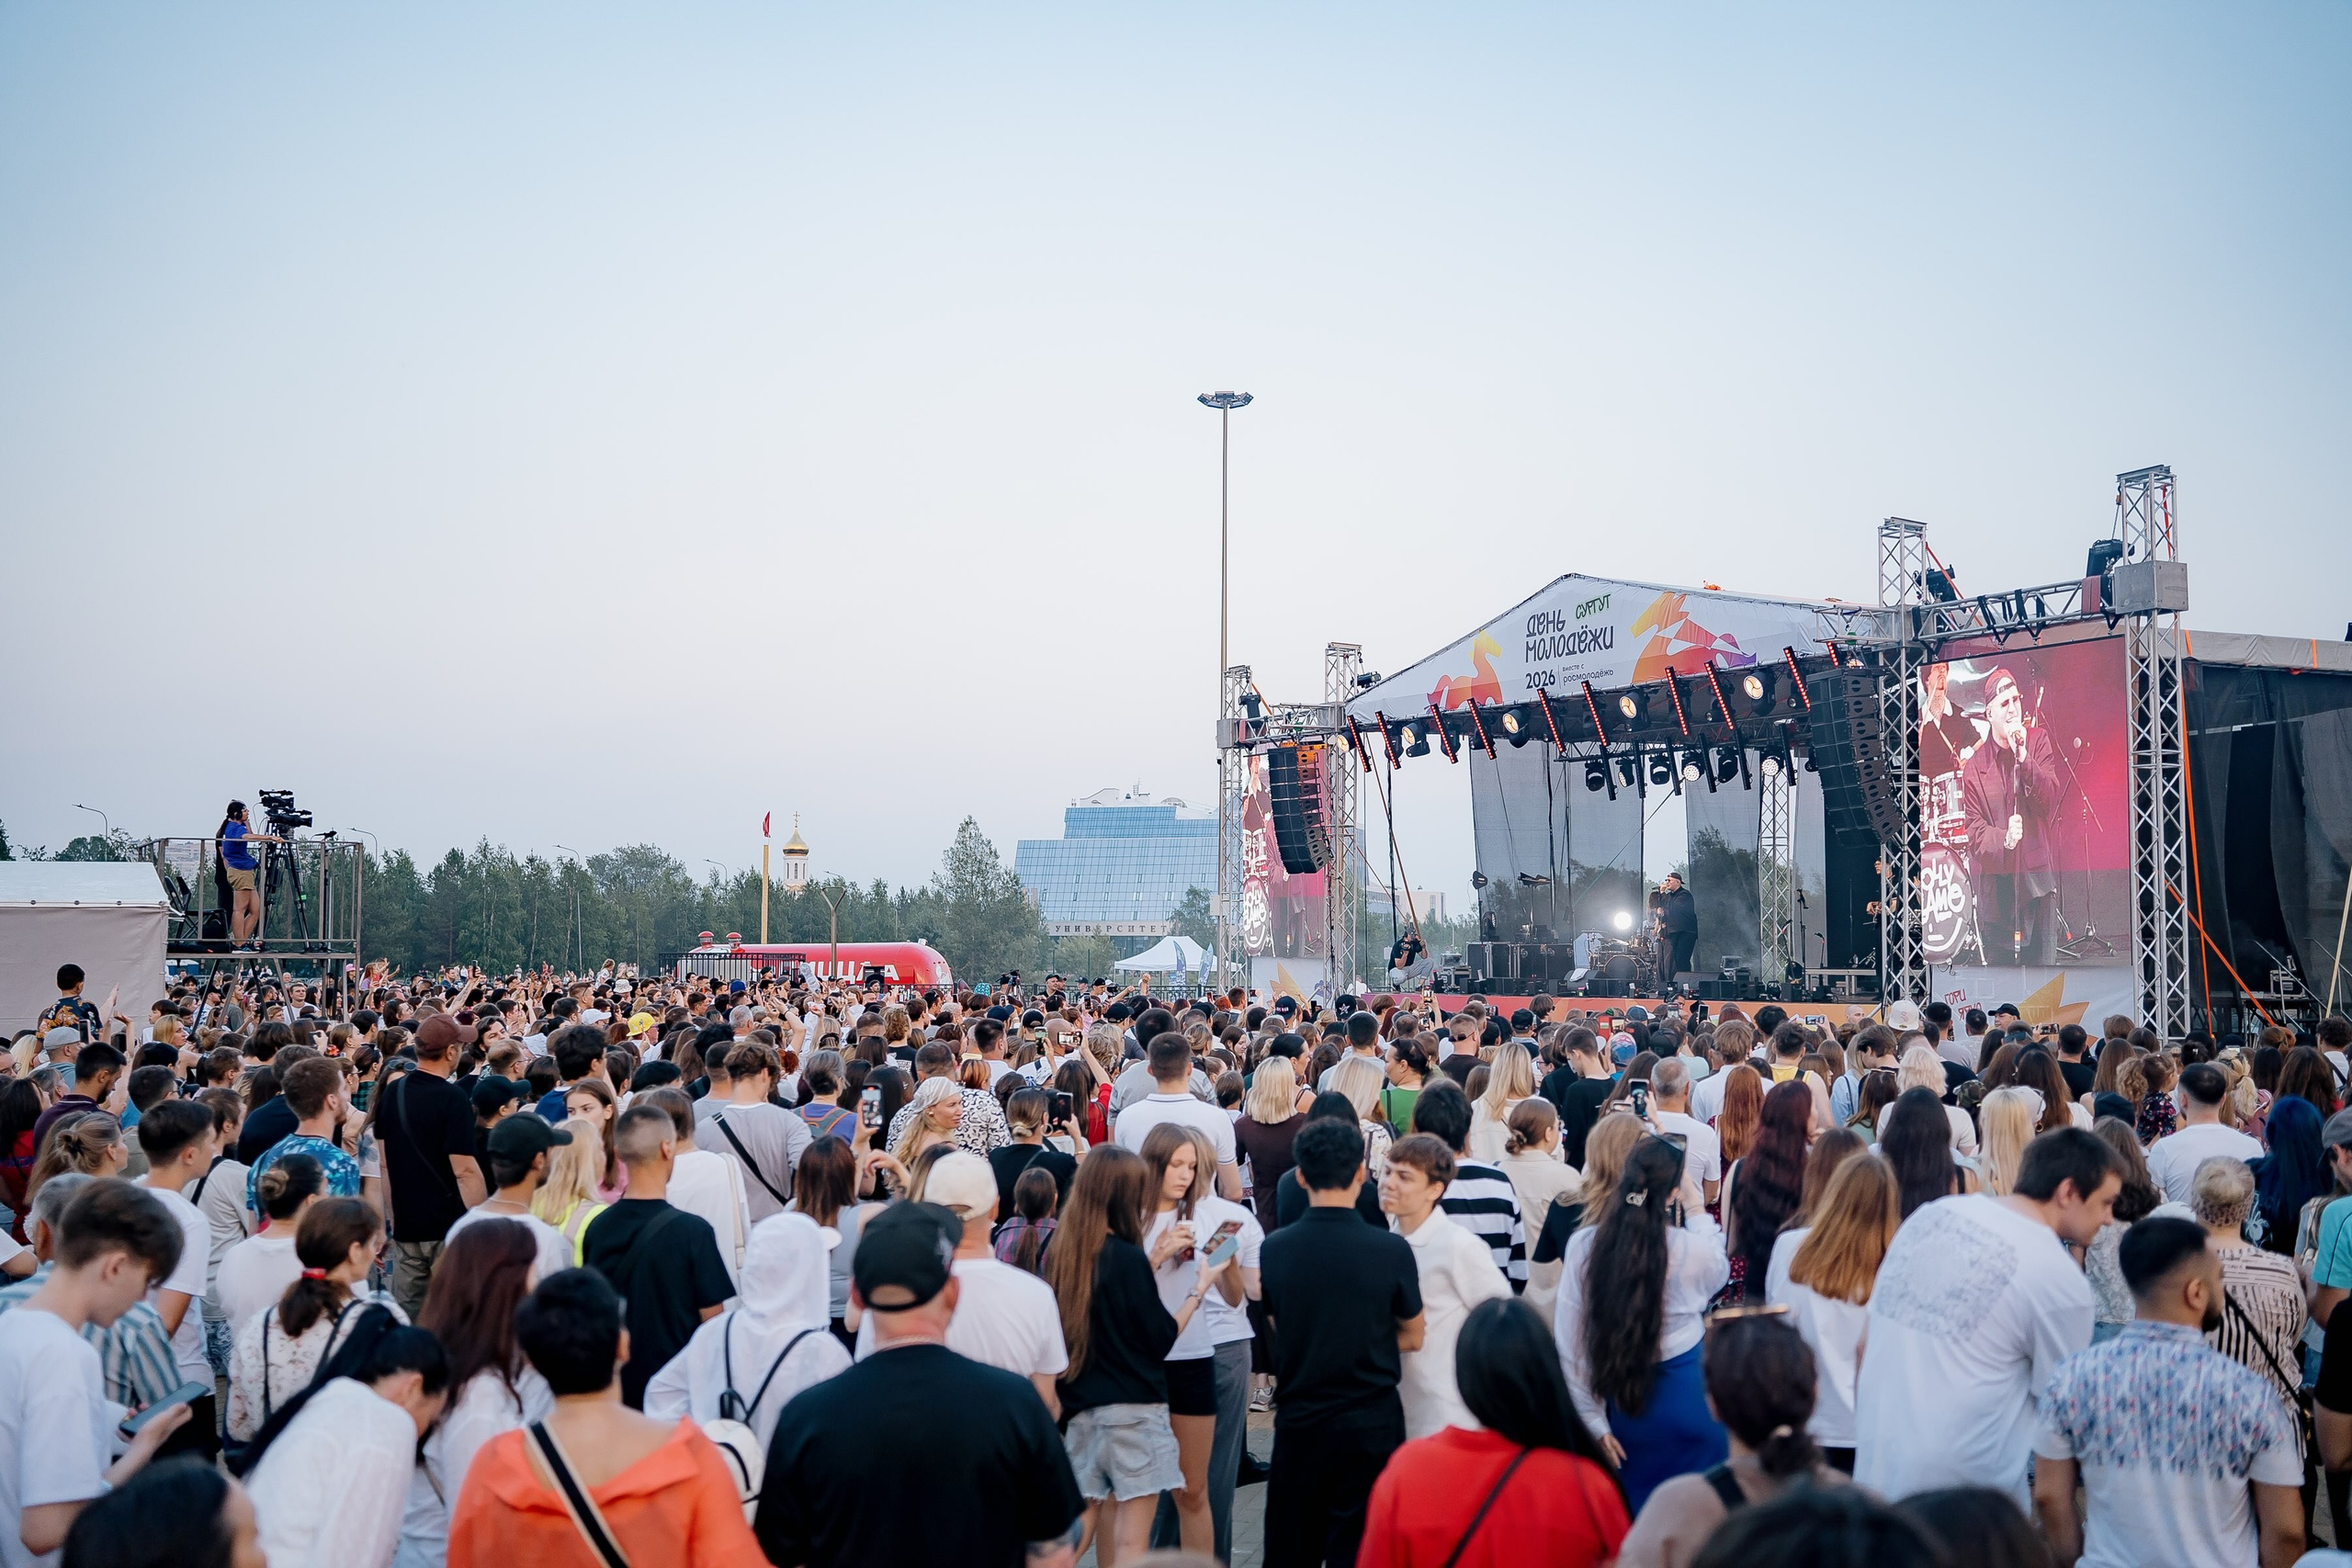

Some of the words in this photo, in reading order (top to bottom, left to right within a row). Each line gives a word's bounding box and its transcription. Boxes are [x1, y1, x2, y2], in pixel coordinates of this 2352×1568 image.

[1576, 593, 1611, 620] СУРГУТ
[1525, 625, 1614, 663] МОЛОДЁЖИ
[1525, 669, 1556, 690] 2026
[1944, 988, 1967, 1006] ГОРИ
[1958, 1002, 1982, 1021] ЯРО
